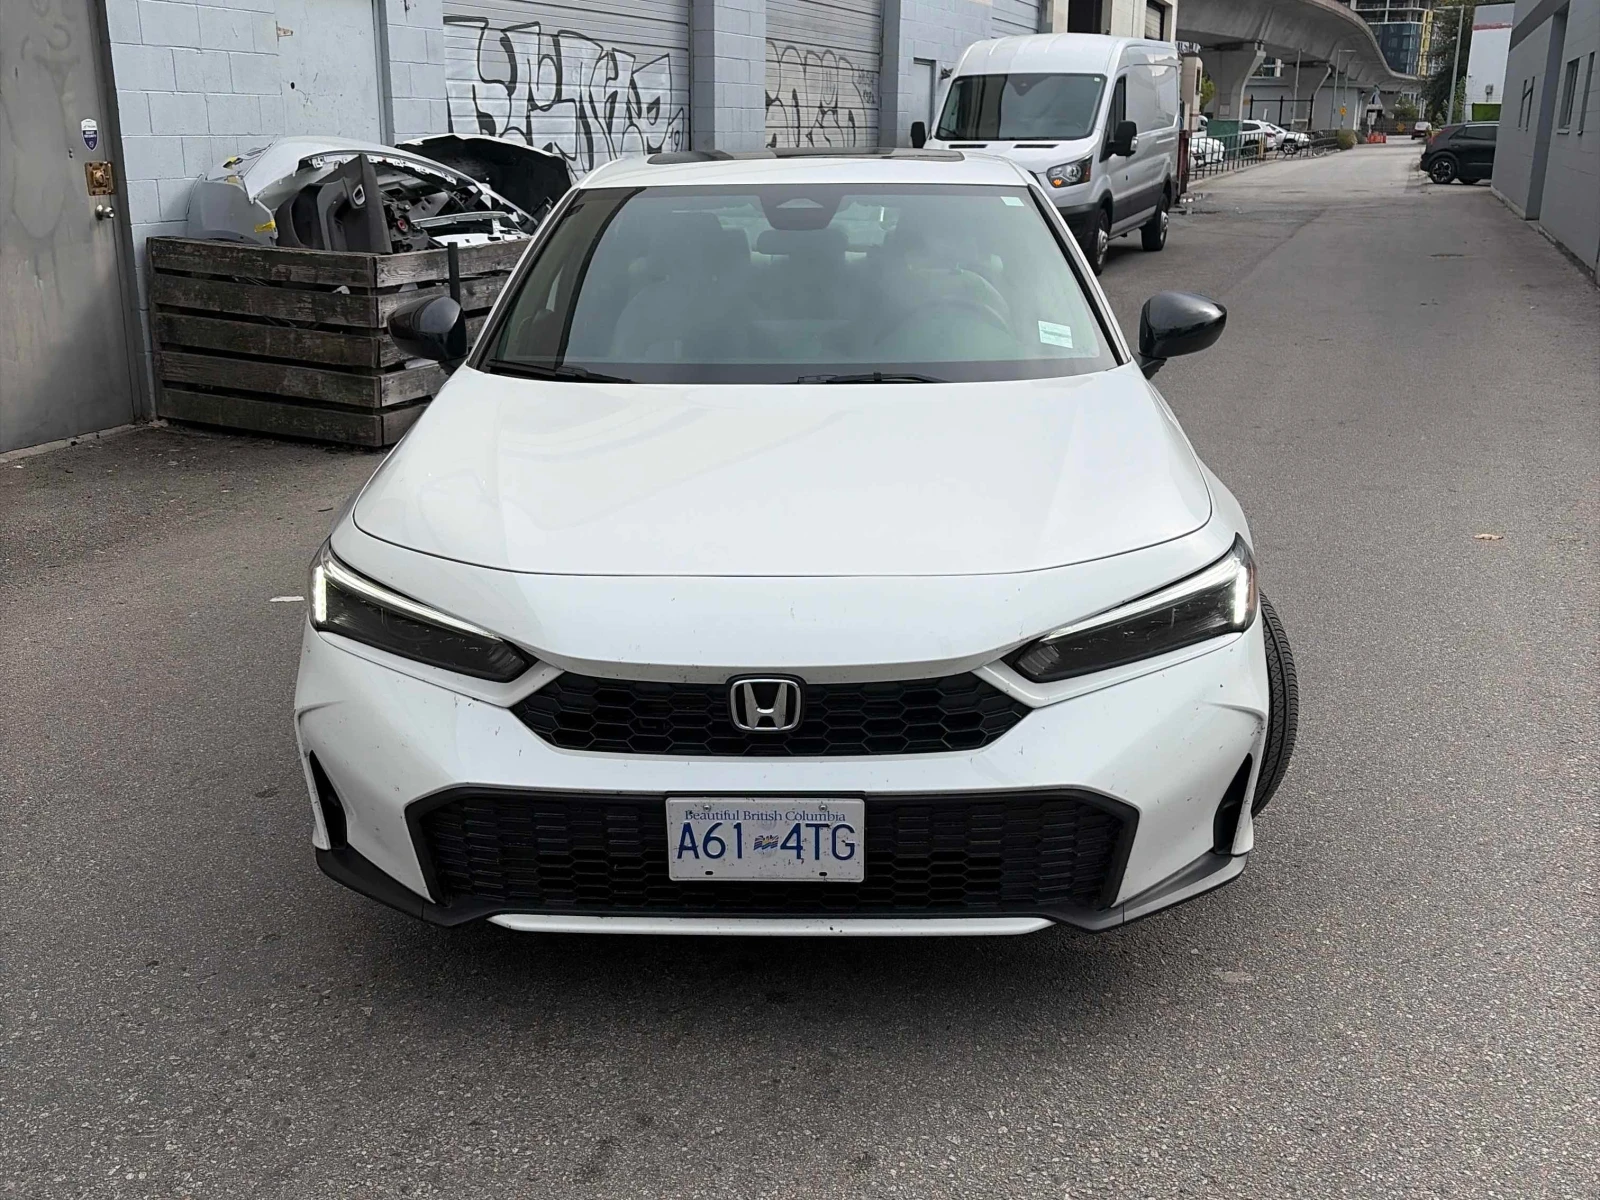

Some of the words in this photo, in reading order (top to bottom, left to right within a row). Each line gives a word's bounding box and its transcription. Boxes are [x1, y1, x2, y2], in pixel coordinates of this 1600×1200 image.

[685, 810, 739, 821] Beautiful
[743, 810, 782, 821] British
[785, 810, 846, 822] Columbia
[676, 822, 743, 860] A61
[780, 823, 856, 861] 4TG
